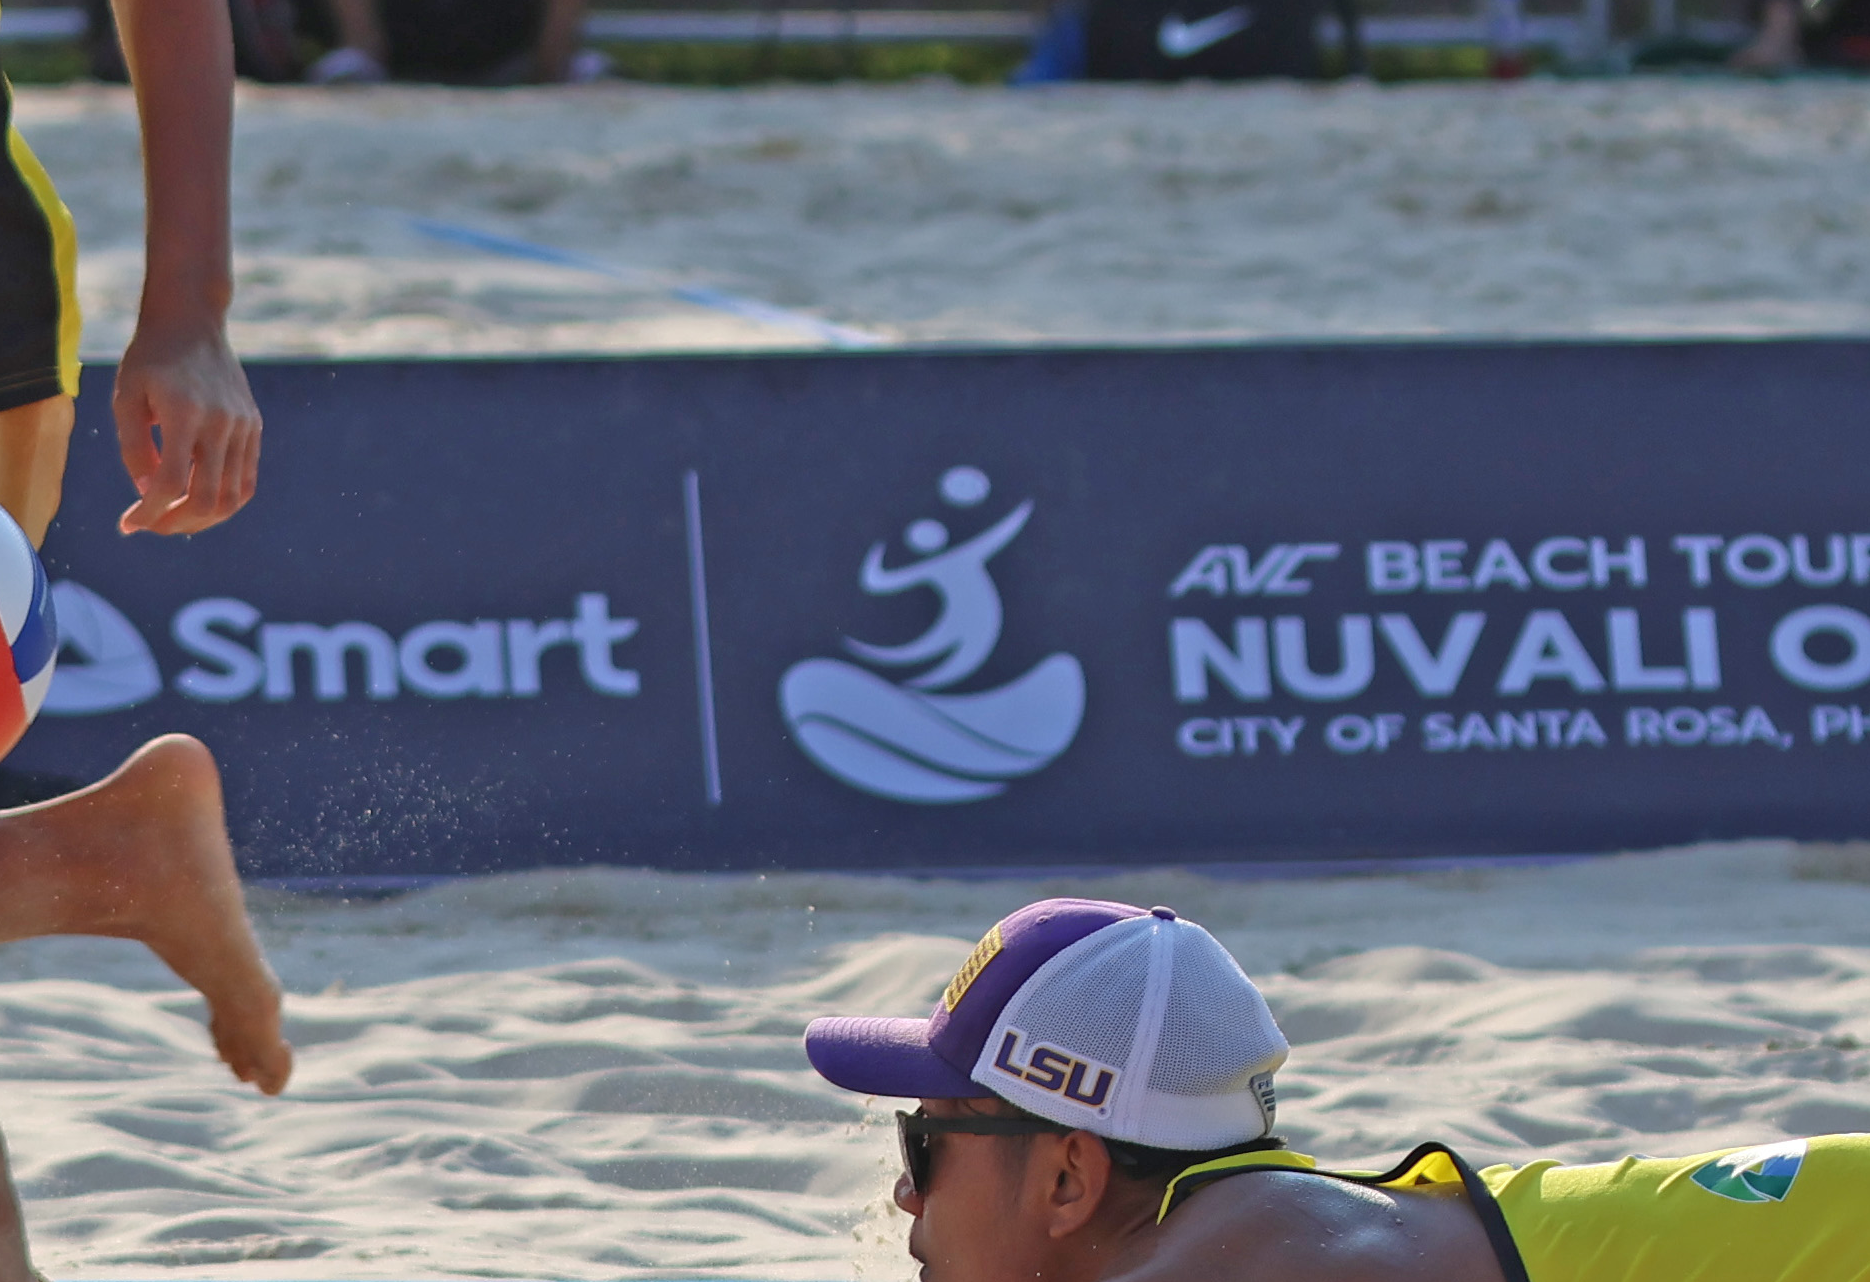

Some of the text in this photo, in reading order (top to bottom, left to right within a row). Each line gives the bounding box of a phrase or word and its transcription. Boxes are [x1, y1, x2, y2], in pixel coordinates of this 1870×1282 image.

[1367, 536, 1648, 592] BEACH
[173, 592, 640, 701] Smart
[1171, 607, 1721, 701] NUVALI
[1177, 717, 1303, 757] CITY
[1325, 713, 1405, 753] OF
[1423, 709, 1607, 751] SANTA
[1625, 705, 1793, 750] ROSA,
[993, 1030, 1115, 1108] LSU
